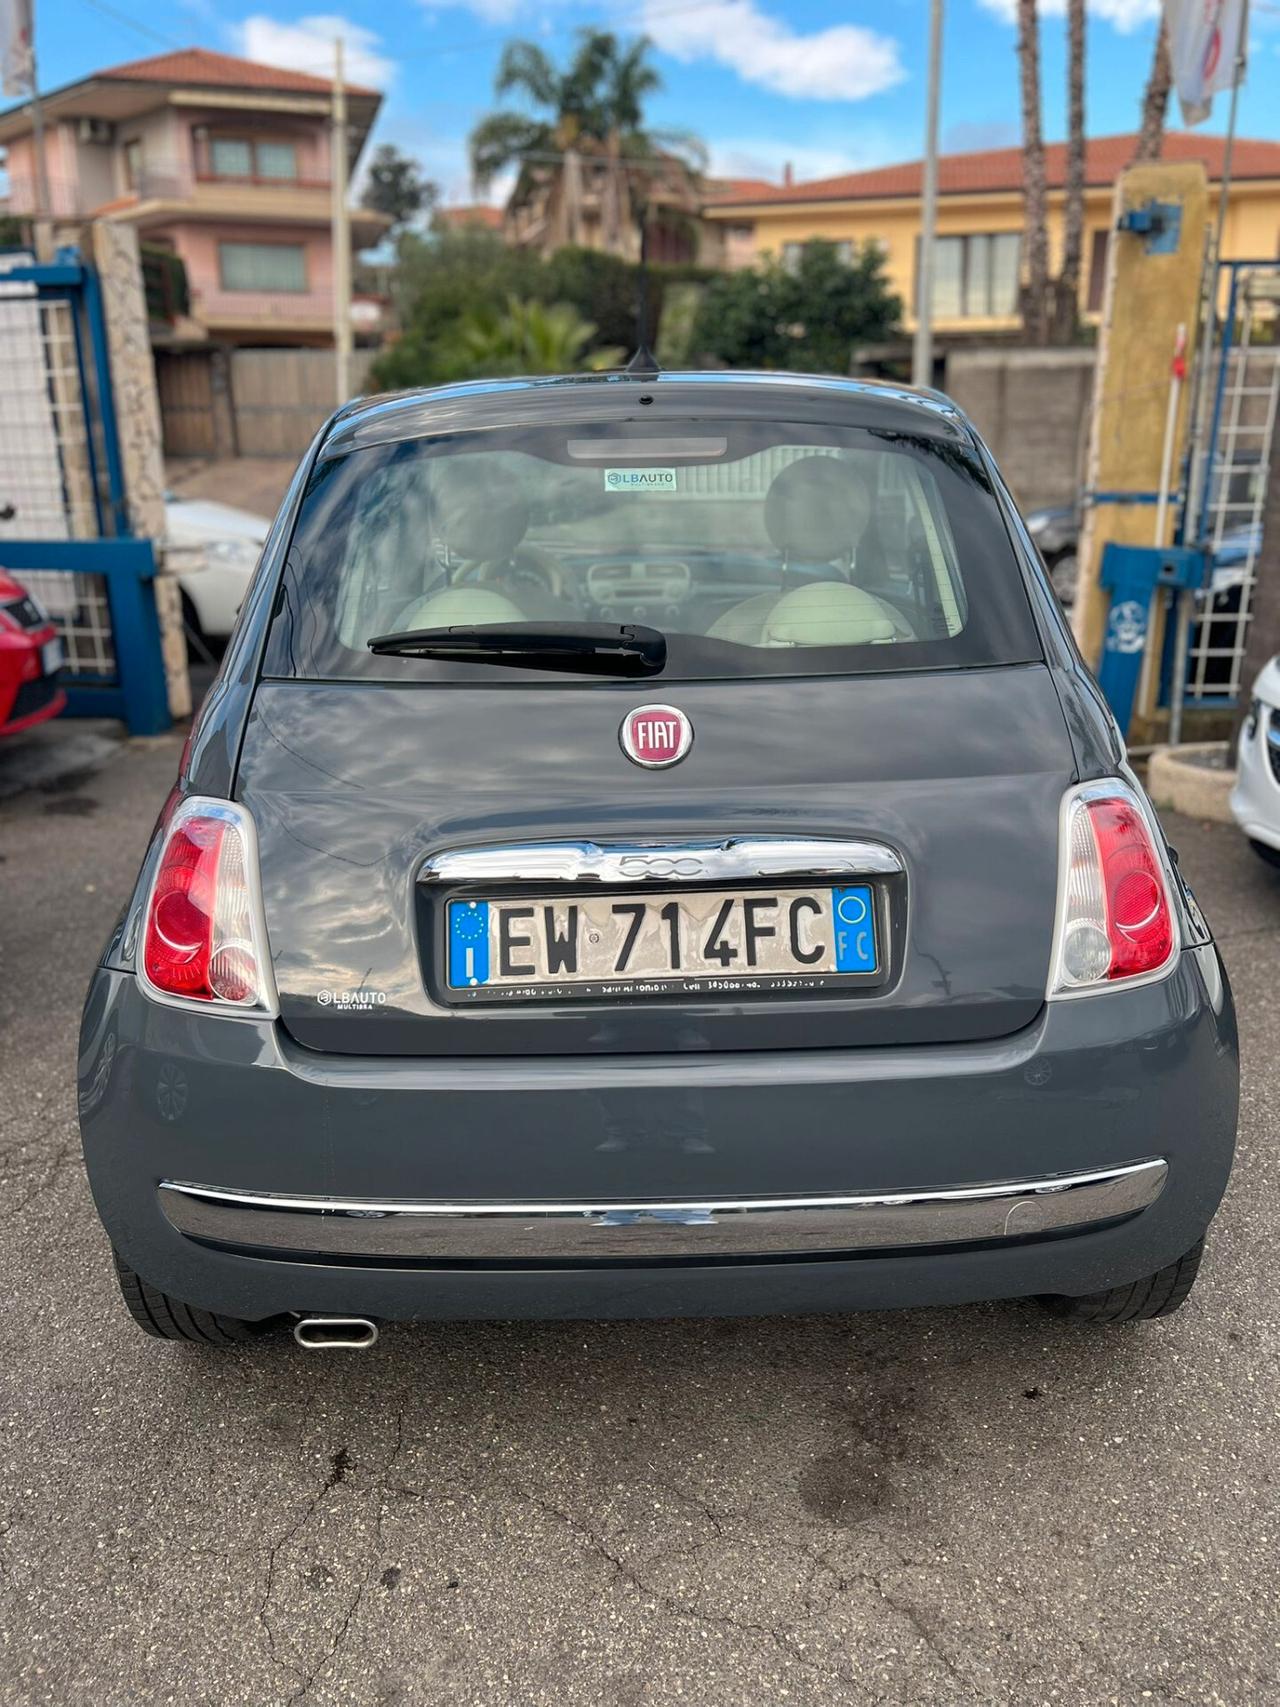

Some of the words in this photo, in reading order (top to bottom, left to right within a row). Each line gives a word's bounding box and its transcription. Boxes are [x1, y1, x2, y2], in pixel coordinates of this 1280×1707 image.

[623, 473, 673, 483] LBAUTO
[637, 721, 677, 749] FIAT
[619, 856, 703, 878] 500
[838, 931, 869, 961] FC
[333, 992, 386, 1004] LBAUTO
